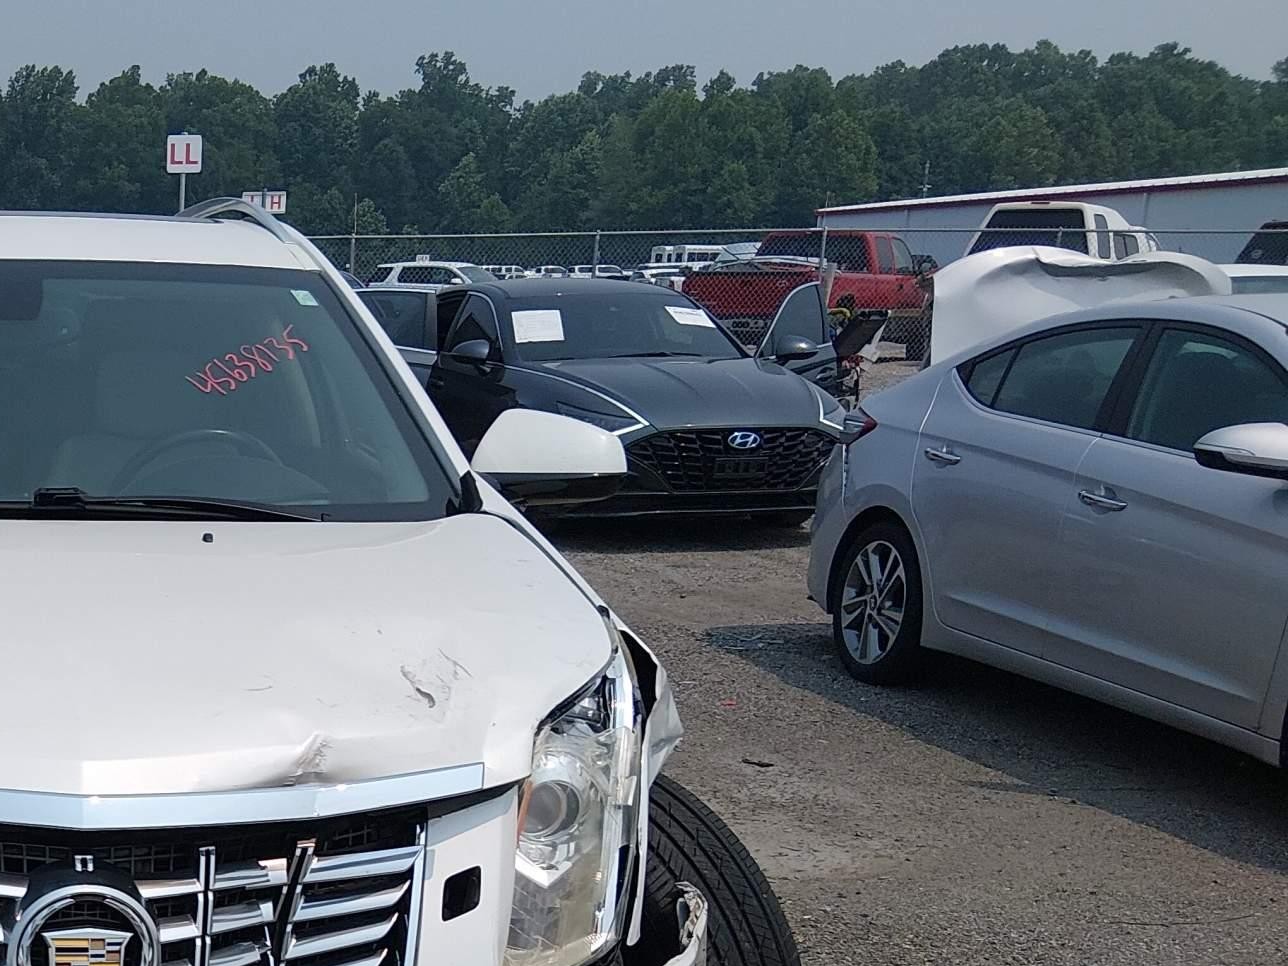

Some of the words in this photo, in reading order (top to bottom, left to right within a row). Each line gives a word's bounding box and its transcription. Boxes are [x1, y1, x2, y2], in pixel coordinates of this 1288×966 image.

[170, 143, 199, 165] LL
[270, 194, 281, 209] H
[185, 324, 308, 394] 45638135
